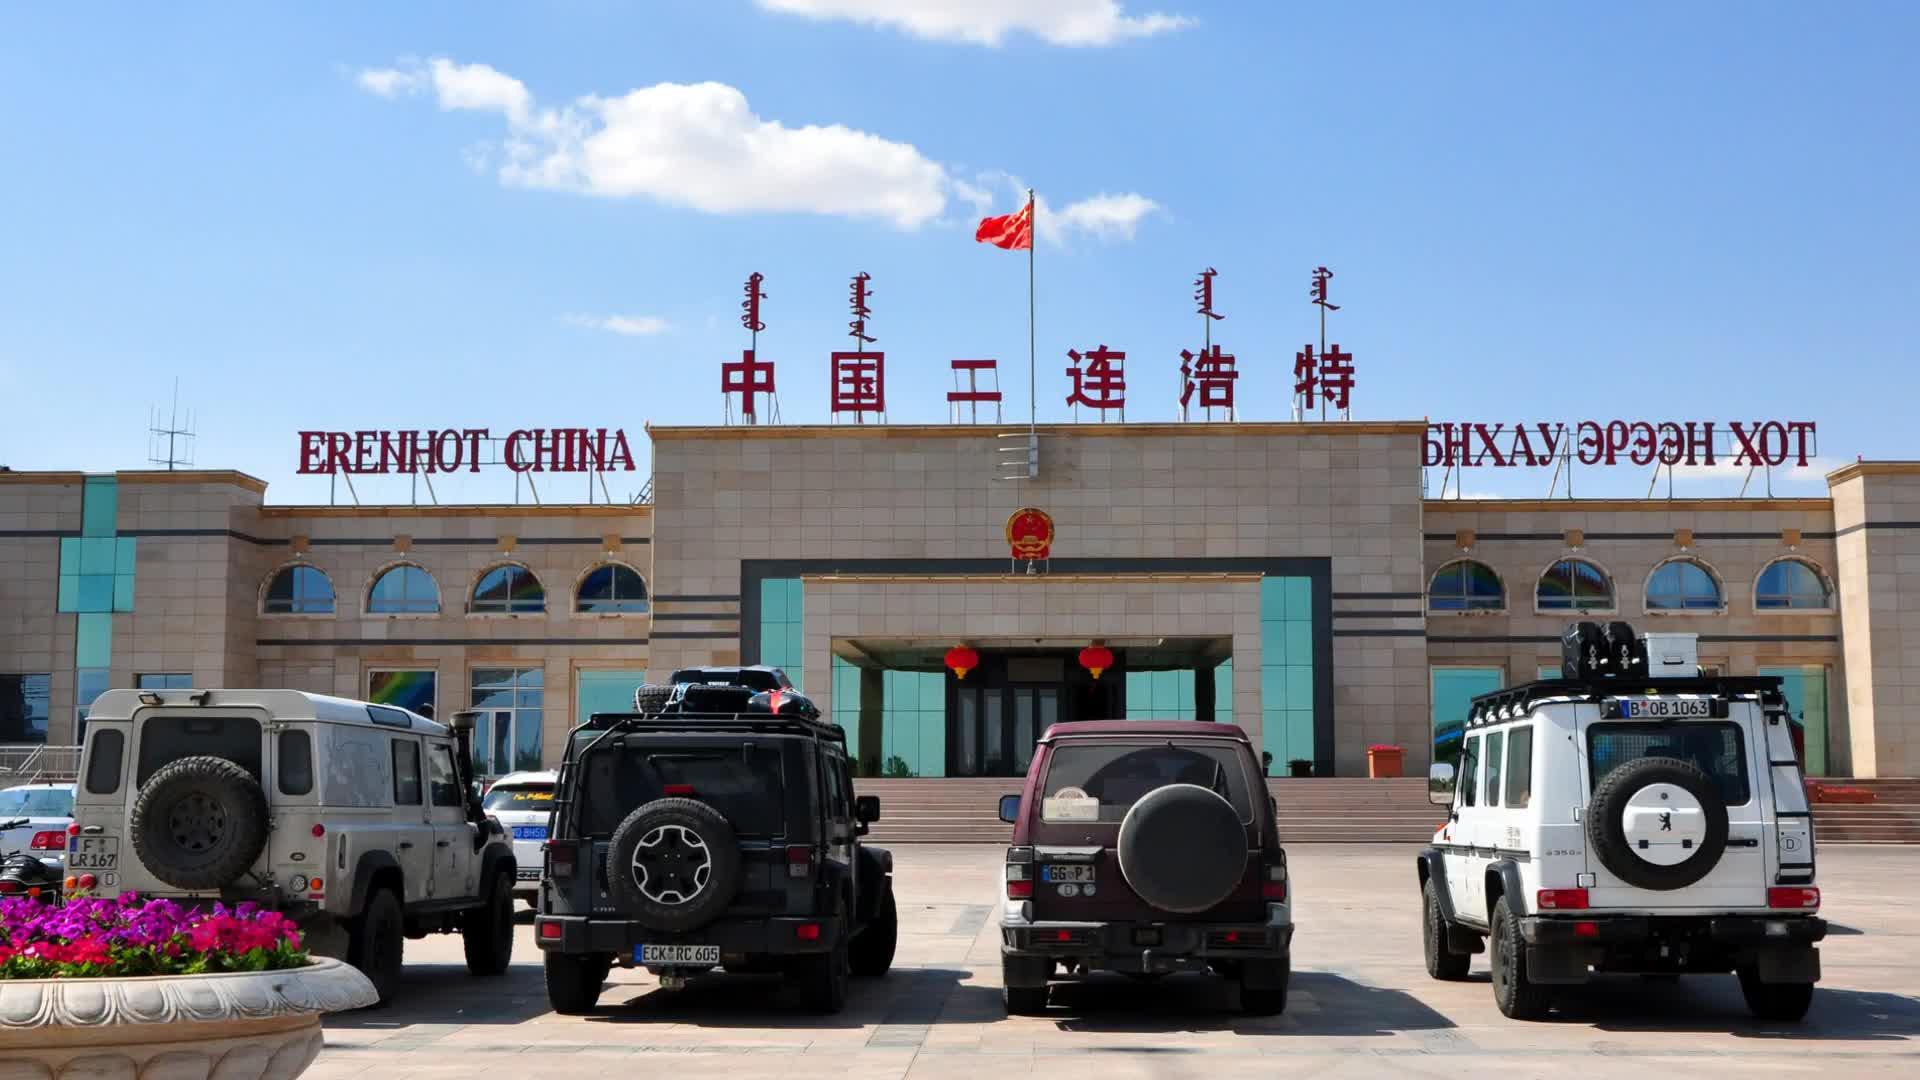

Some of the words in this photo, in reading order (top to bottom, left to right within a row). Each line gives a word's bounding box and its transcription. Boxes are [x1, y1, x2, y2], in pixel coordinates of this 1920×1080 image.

[721, 345, 1355, 413] 中国二连浩特
[296, 428, 489, 474] ERENHOT
[504, 428, 636, 472] CHINA
[1422, 422, 1563, 467] БНХАУ
[1577, 420, 1716, 466] ЭРЭЭН
[1730, 421, 1817, 467] ХОТ
[1631, 702, 1640, 716] B
[1672, 701, 1707, 715] 1063
[84, 839, 93, 852] F
[643, 946, 668, 961] ECK
[676, 947, 692, 961] RC
[695, 947, 719, 961] 605
